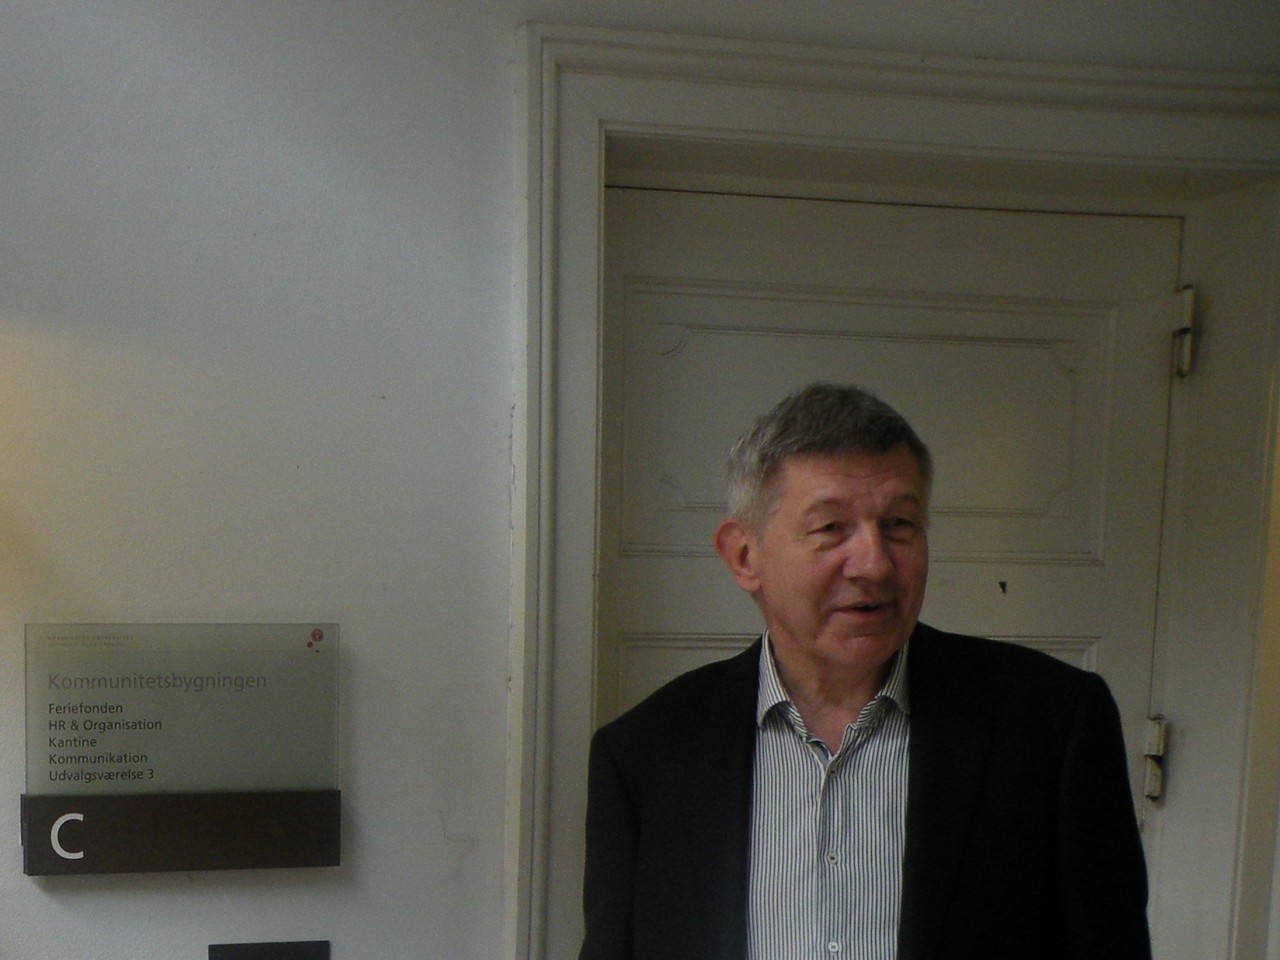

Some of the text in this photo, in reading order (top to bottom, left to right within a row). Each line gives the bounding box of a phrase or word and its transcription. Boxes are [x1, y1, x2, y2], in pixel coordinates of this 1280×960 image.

[47, 672, 268, 693] Kommunitetsbygningen
[48, 702, 124, 715] Feriefonden
[48, 718, 163, 733] HR & Organisation
[48, 736, 97, 748] Kantine
[49, 752, 148, 765] Kommunikation
[49, 769, 154, 783] Udvalgsværelse 3
[50, 812, 85, 860] C
